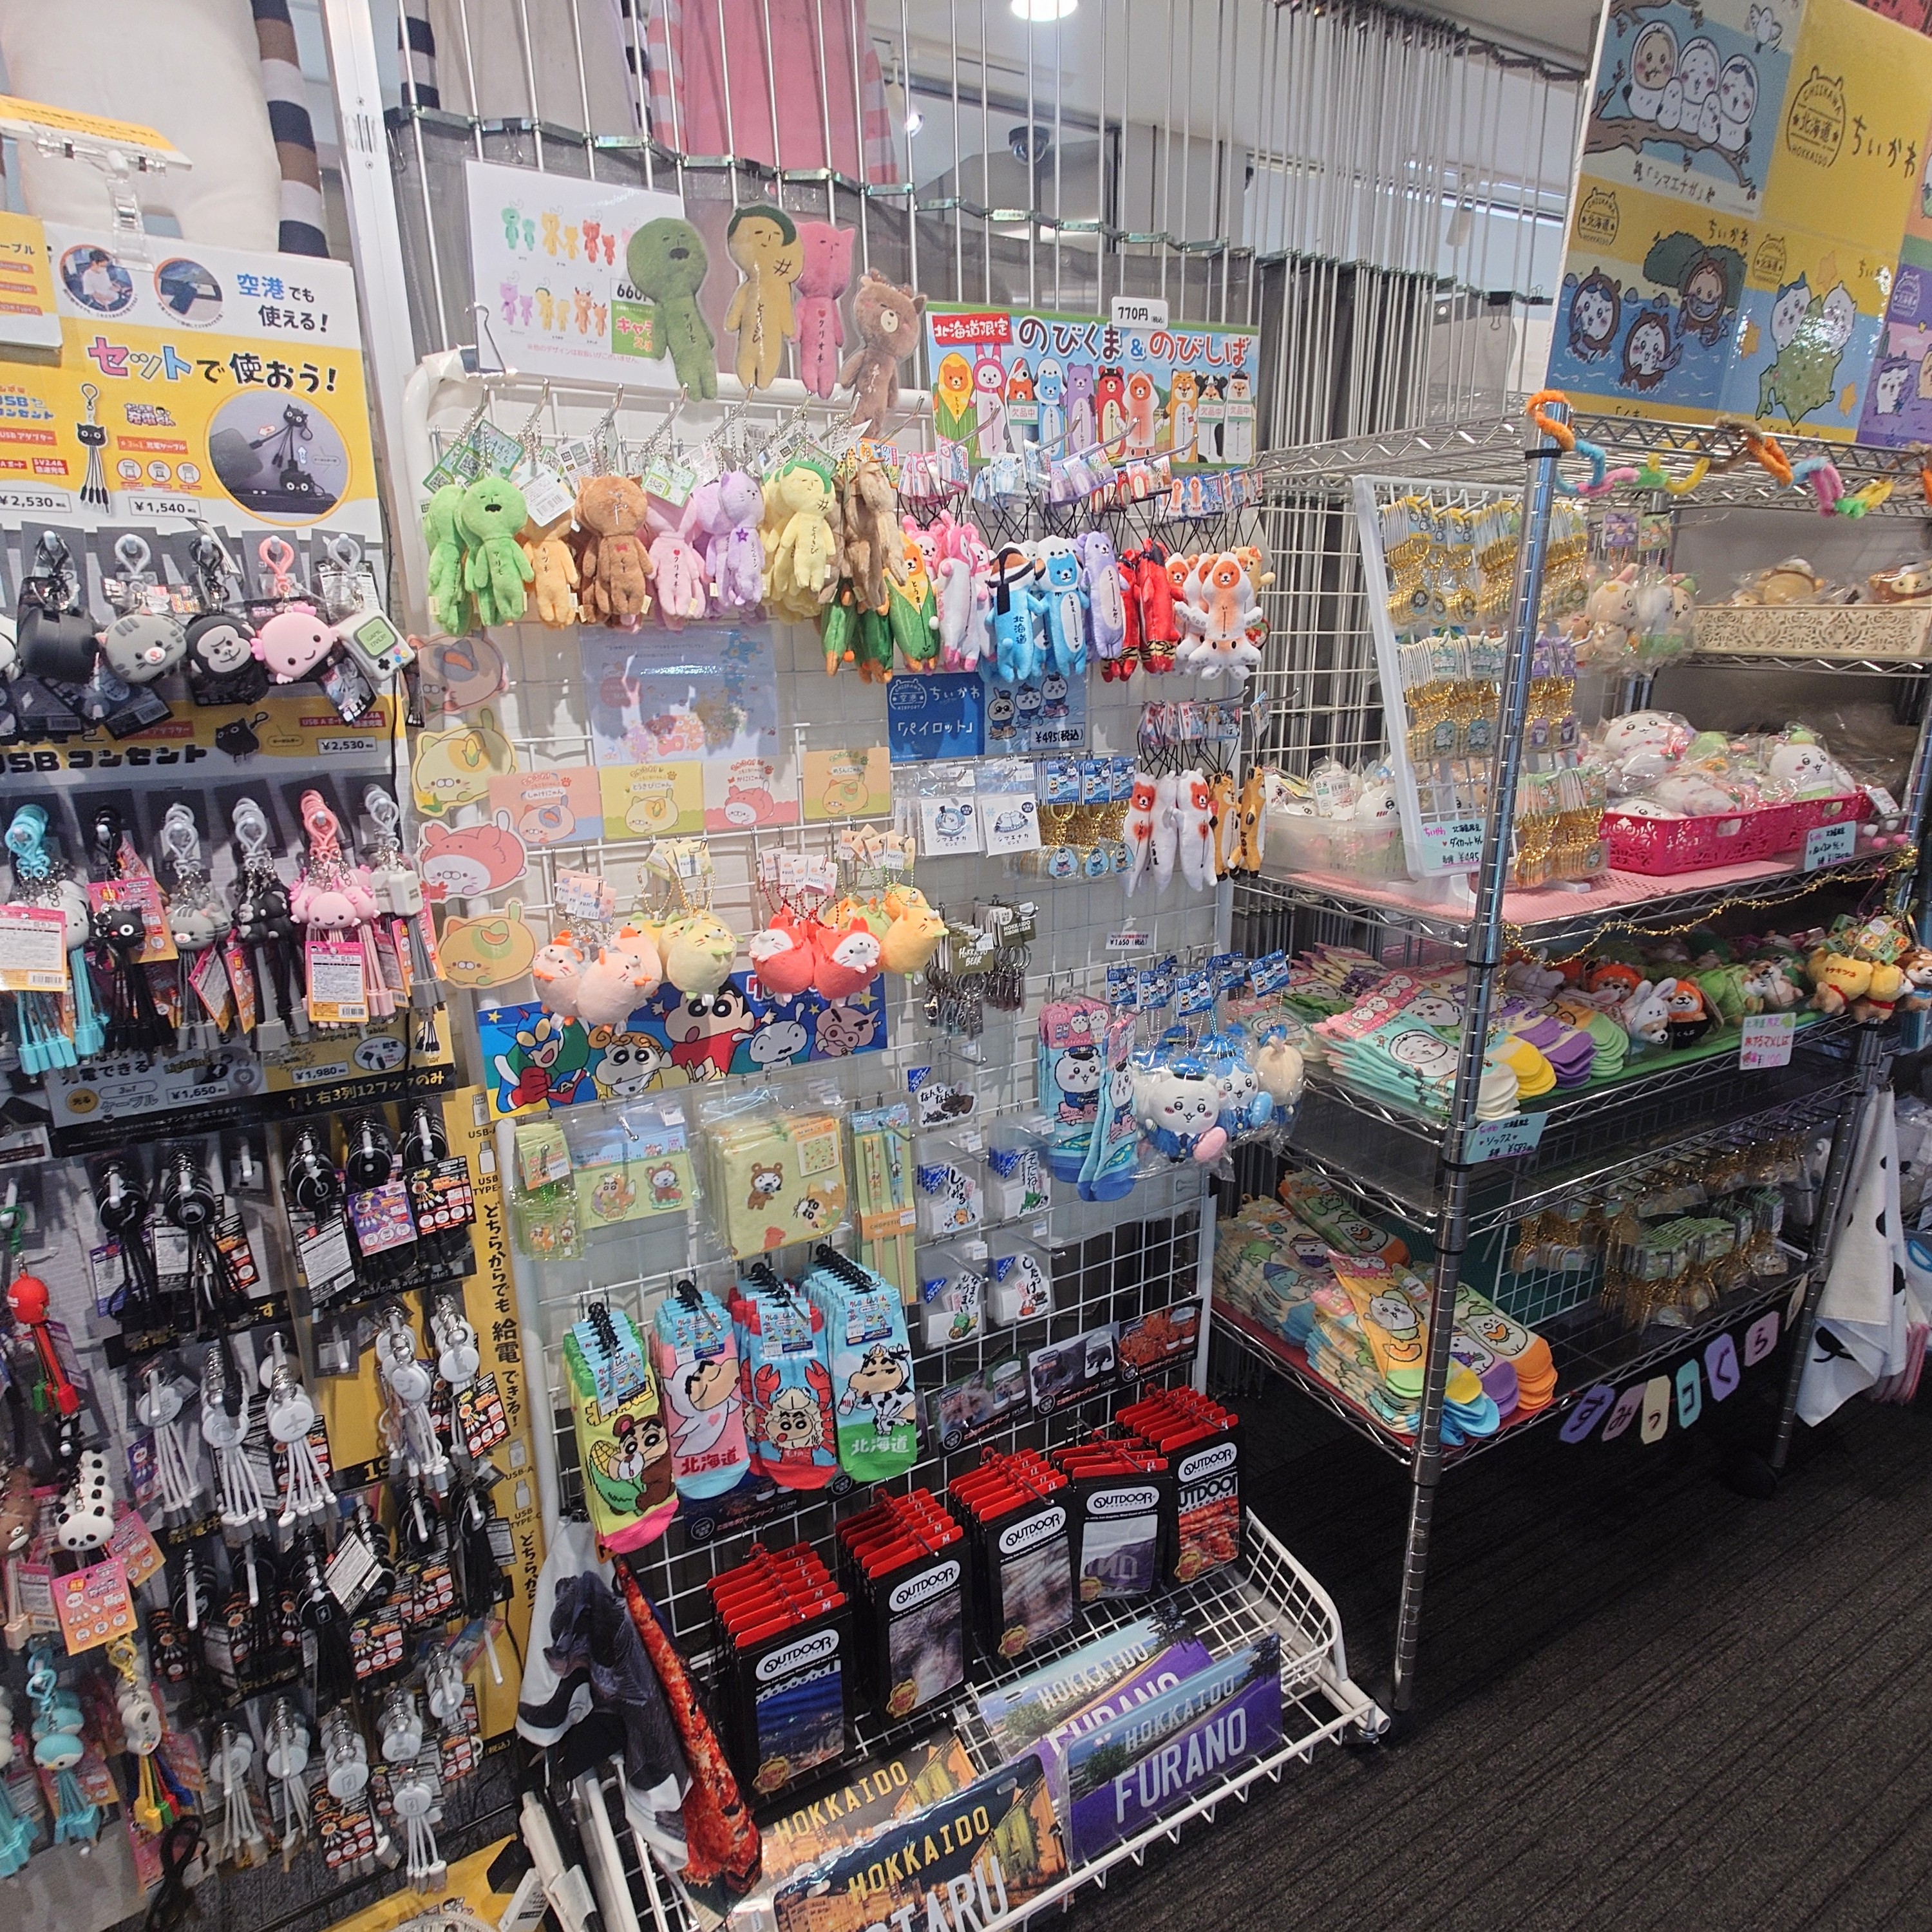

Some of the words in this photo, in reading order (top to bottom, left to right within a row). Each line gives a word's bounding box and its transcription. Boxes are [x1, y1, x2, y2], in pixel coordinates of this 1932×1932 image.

[1801, 111, 1832, 142] 北海道
[1852, 115, 1917, 178] ちいかわ
[1587, 216, 1610, 232] 北海道
[1709, 219, 1749, 246] ちいかわ
[237, 274, 284, 300] 空港
[289, 287, 314, 303] でも
[617, 284, 648, 303] 660
[258, 305, 328, 333] 使える!
[1117, 306, 1149, 322] 770円
[933, 320, 1009, 341] 北海道限定
[817, 319, 826, 364] クリオネ
[1018, 317, 1123, 361] のびくま
[1131, 339, 1145, 359] &
[1149, 332, 1252, 366] のびしば
[87, 337, 337, 393] セットで使おう!
[1012, 407, 1035, 418] 欠品中
[1200, 406, 1223, 416] 欠品中
[1229, 406, 1250, 415] 欠品中
[135, 502, 185, 515] ¥1,540
[1013, 616, 1028, 645] 北海道
[900, 694, 917, 703] 空港
[929, 685, 980, 701] ちいかわ
[897, 719, 973, 737] 「パイロット」
[1035, 728, 1084, 743] ¥495(税込)
[322, 740, 365, 751] ¥2,530
[0, 751, 61, 773] SB
[68, 744, 207, 768] コンセント
[527, 790, 564, 799] しゃけにゃん
[632, 782, 672, 791] とうきびにゃん
[998, 833, 1029, 842] シマエナガ
[1003, 919, 1032, 931] HOKKAIDO
[965, 956, 983, 967] BEAR
[296, 1066, 337, 1080] ¥1,980
[171, 1085, 216, 1100] ¥1,650
[920, 1086, 943, 1102] なんも
[100, 1095, 159, 1112] ケーブル
[478, 1175, 498, 1186] USB
[473, 1184, 502, 1196] TYPE-
[851, 1437, 909, 1455] 北海道
[681, 1447, 739, 1475] 北海道
[1184, 1448, 1233, 1475] OUTDOOR
[505, 1466, 535, 1481] USB-A
[1094, 1492, 1153, 1508] OUTDOOR
[515, 1508, 533, 1519] USB
[1006, 1514, 1061, 1547] OUTDOOR
[896, 1567, 954, 1604] OUTDOOR
[764, 1636, 831, 1673] OUTDOOR
[1037, 1642, 1150, 1710] HOKKAIDO
[1125, 1675, 1235, 1752] HOKKAIDO
[1115, 1707, 1247, 1824] FURANO
[774, 1761, 909, 1847] HOKKAIDO
[849, 1805, 990, 1906] HOKKAIDO
[864, 1855, 1009, 1932] TARU
